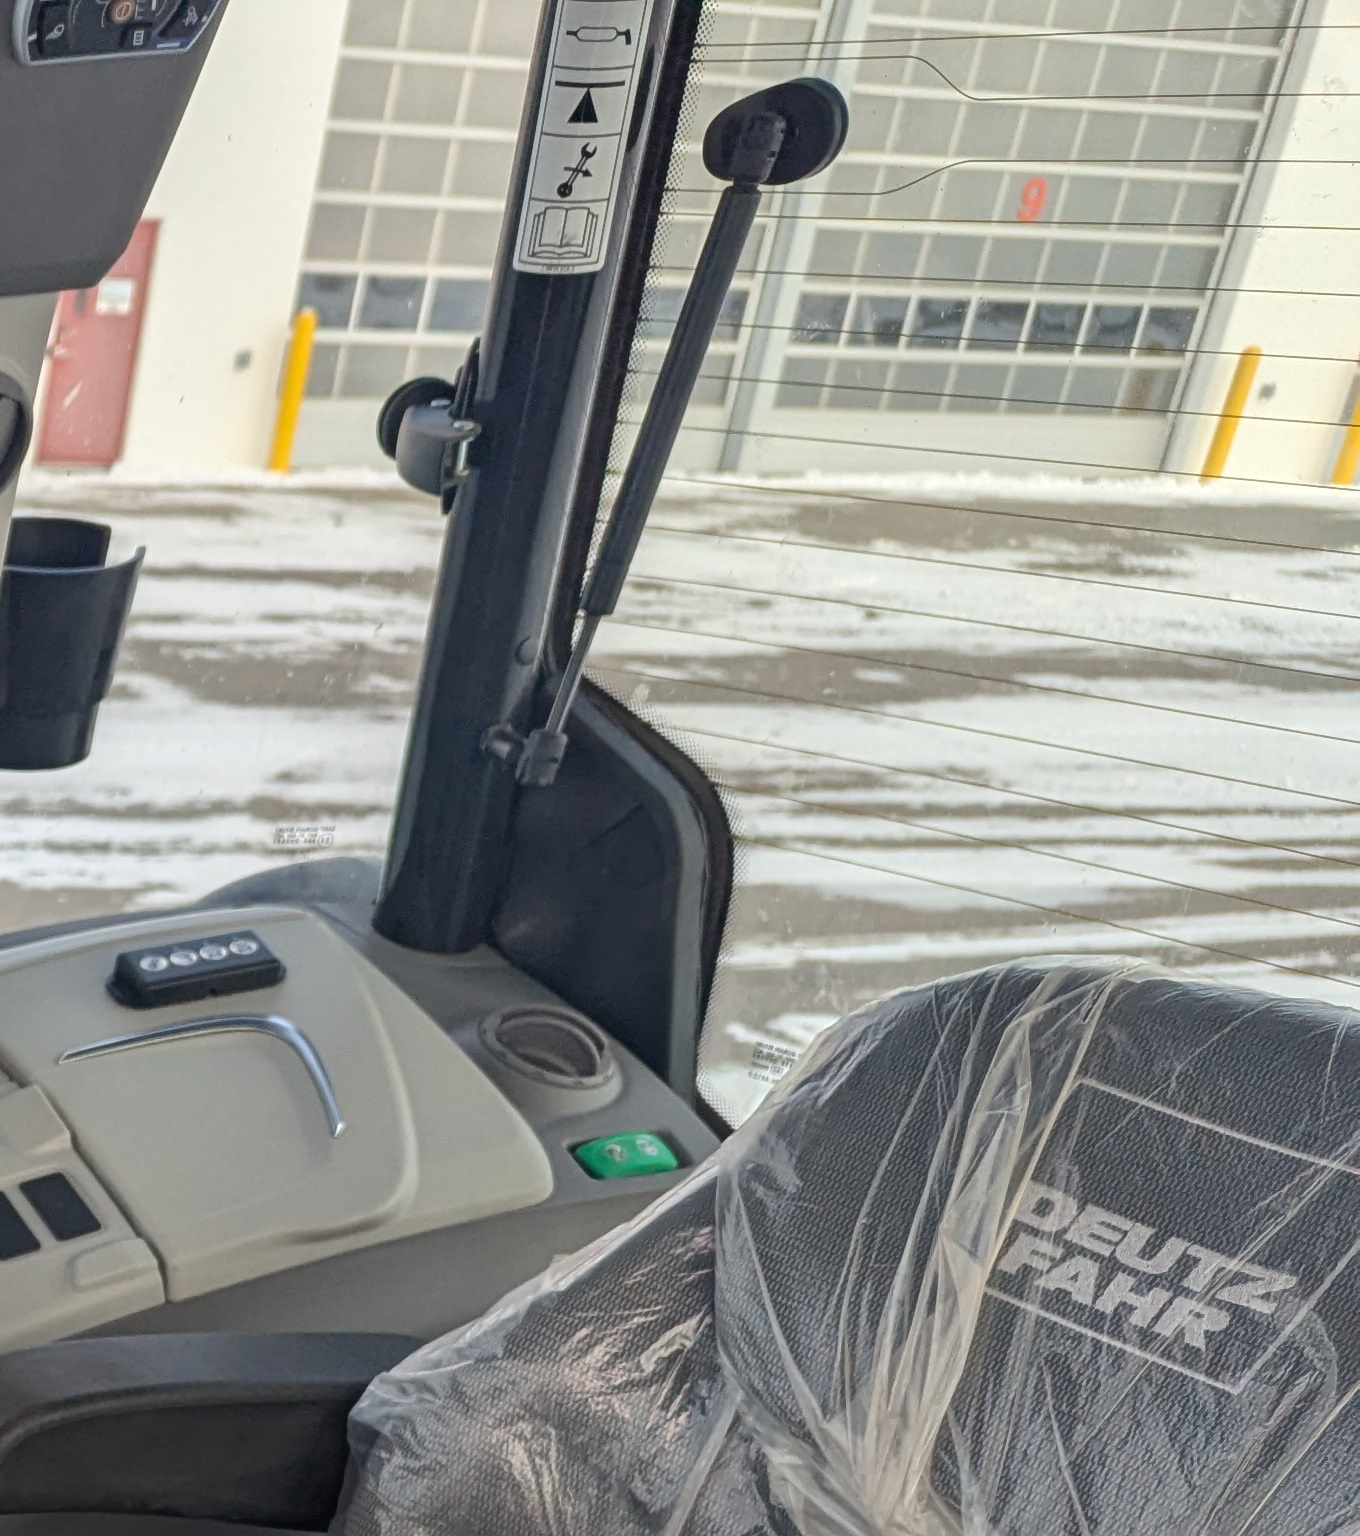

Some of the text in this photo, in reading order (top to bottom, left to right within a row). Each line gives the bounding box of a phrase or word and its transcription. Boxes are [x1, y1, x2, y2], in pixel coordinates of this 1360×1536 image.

[1018, 176, 1047, 224] 9
[994, 1232, 1230, 1352] FAHR
[1012, 1180, 1297, 1315] DEUTZ
